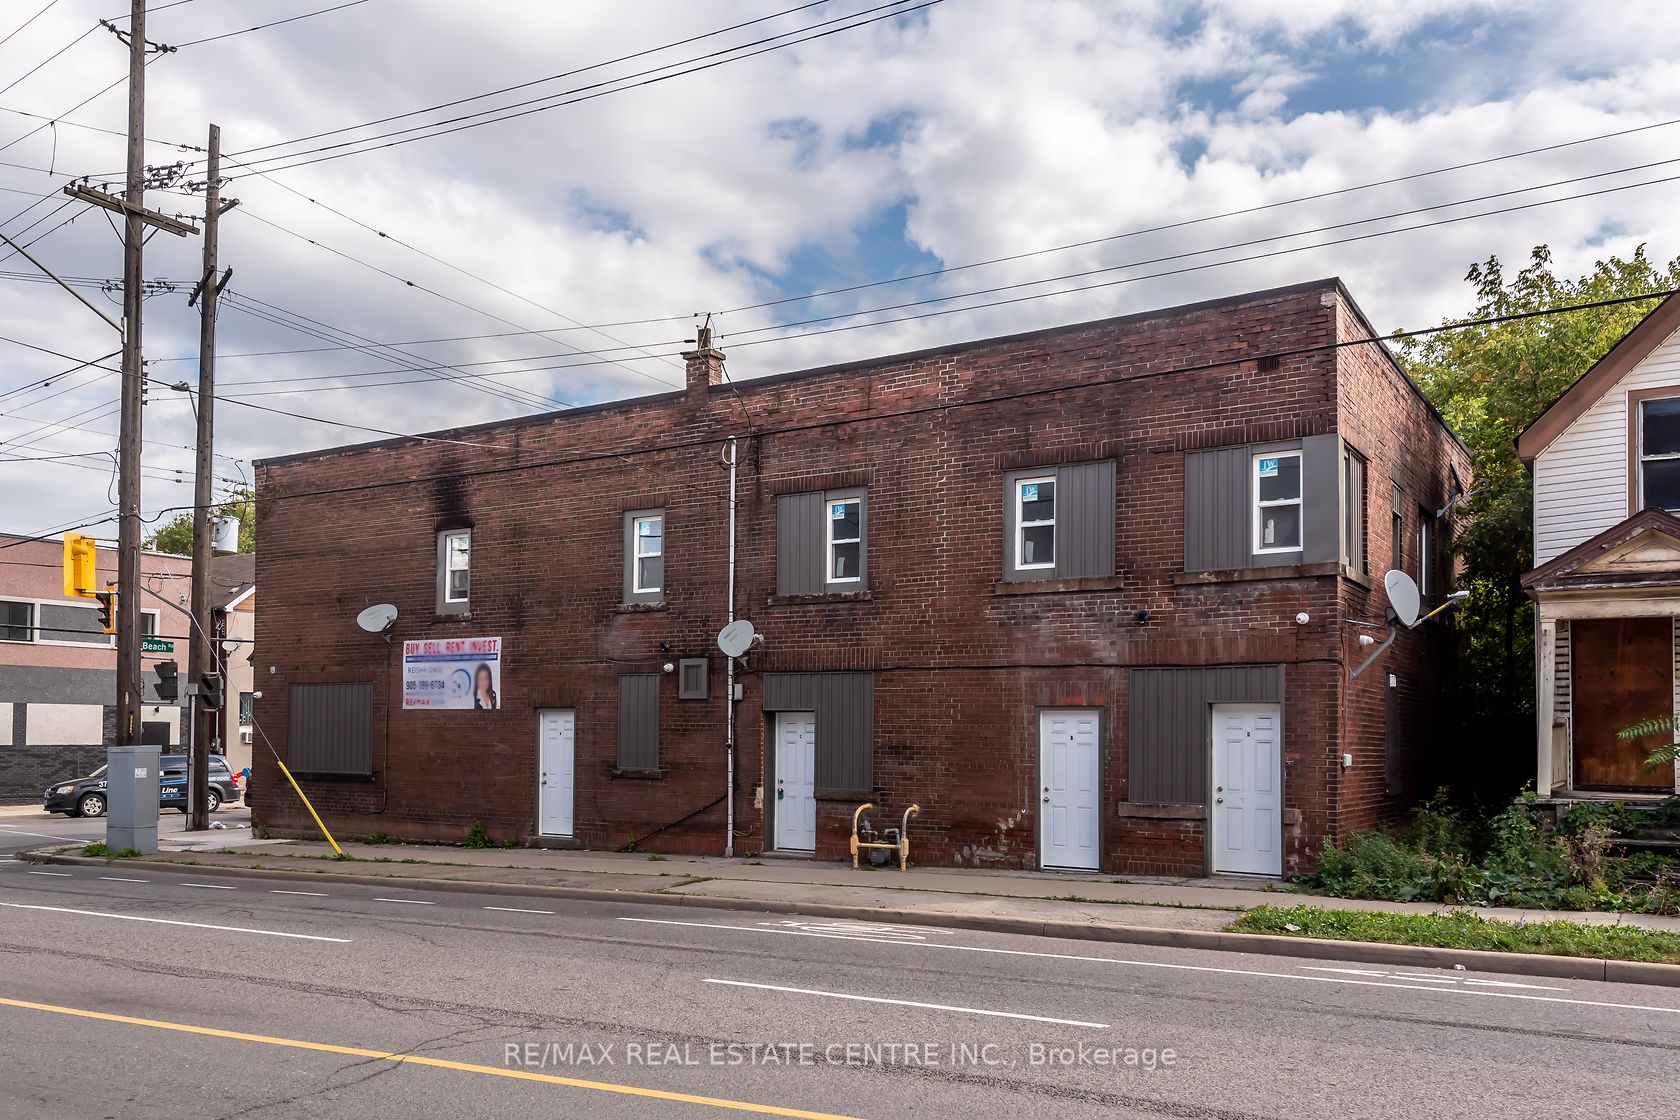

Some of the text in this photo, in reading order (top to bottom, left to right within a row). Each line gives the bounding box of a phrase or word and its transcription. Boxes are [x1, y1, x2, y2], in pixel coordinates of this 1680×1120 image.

[142, 641, 167, 651] Beach
[406, 643, 420, 655] BUY
[424, 642, 441, 654] SELL
[446, 641, 465, 653] RENT
[161, 786, 179, 794] Line
